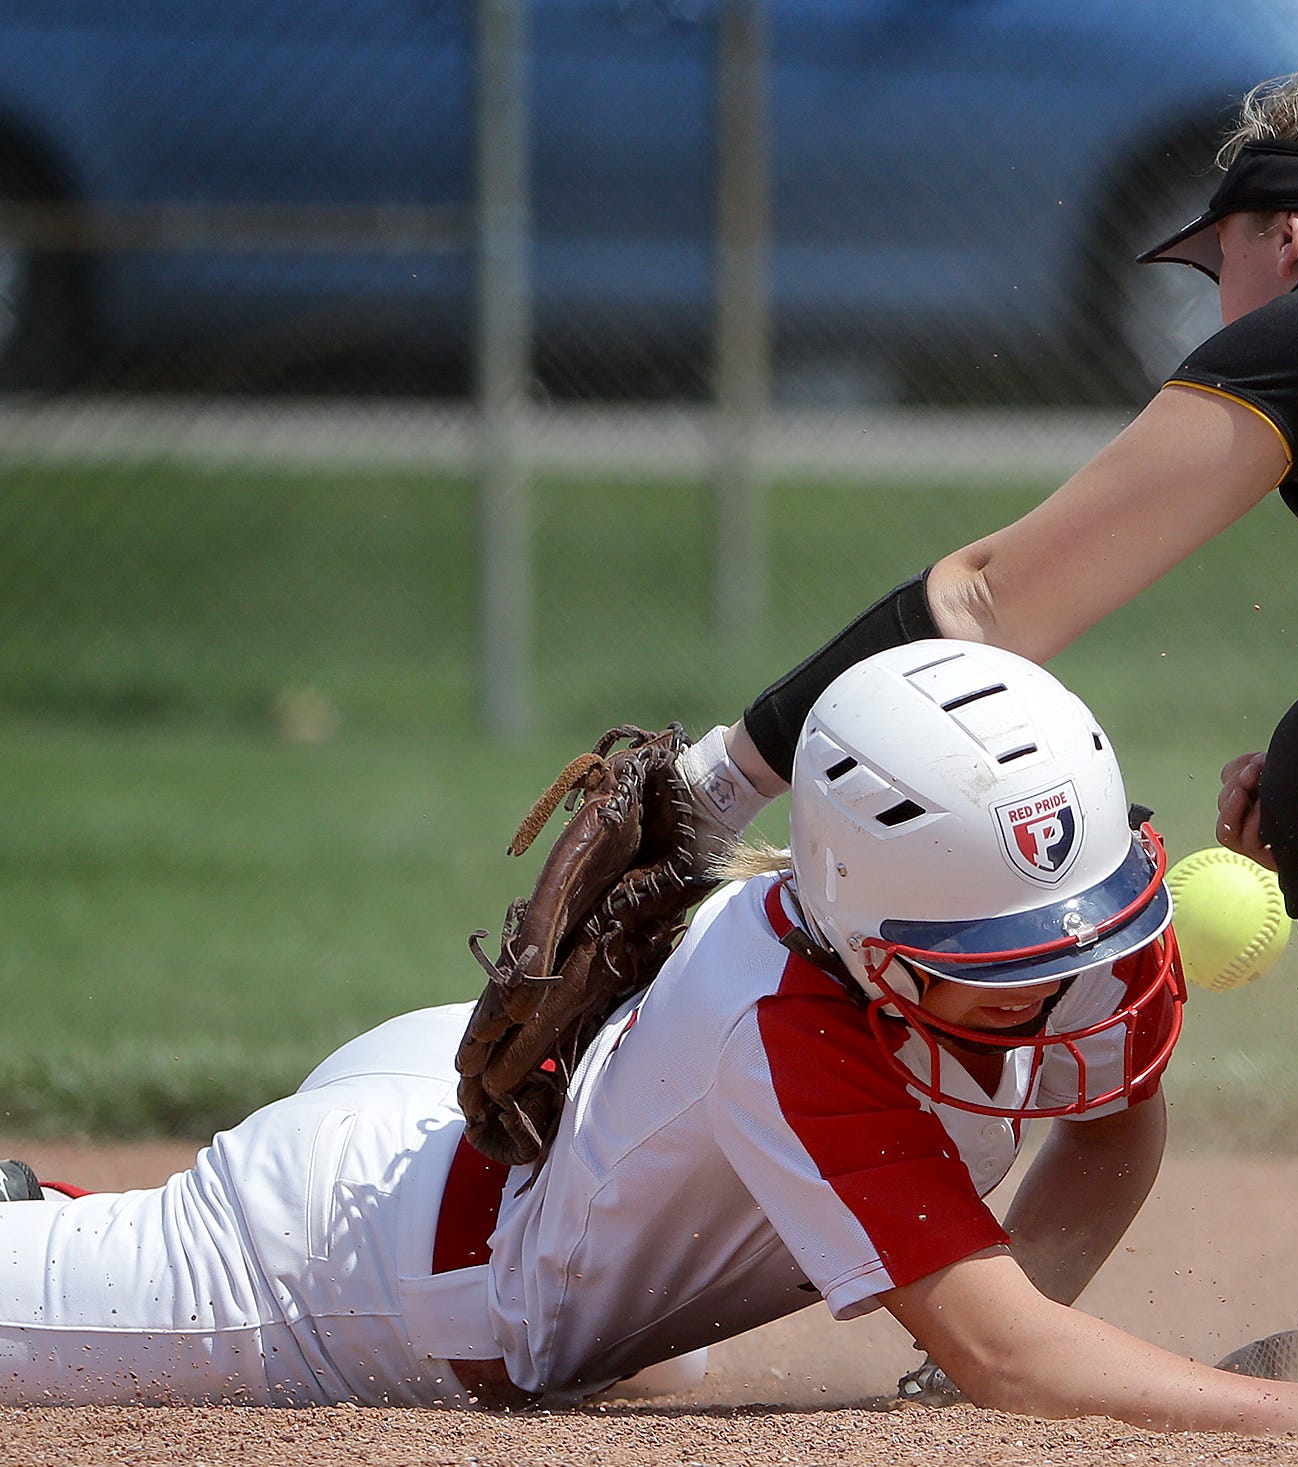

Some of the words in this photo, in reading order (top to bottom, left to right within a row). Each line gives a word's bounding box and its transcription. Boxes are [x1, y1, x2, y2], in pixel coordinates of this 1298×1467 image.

[1008, 805, 1032, 822] RED
[1034, 792, 1067, 814] PRIDE
[1026, 817, 1064, 870] P
